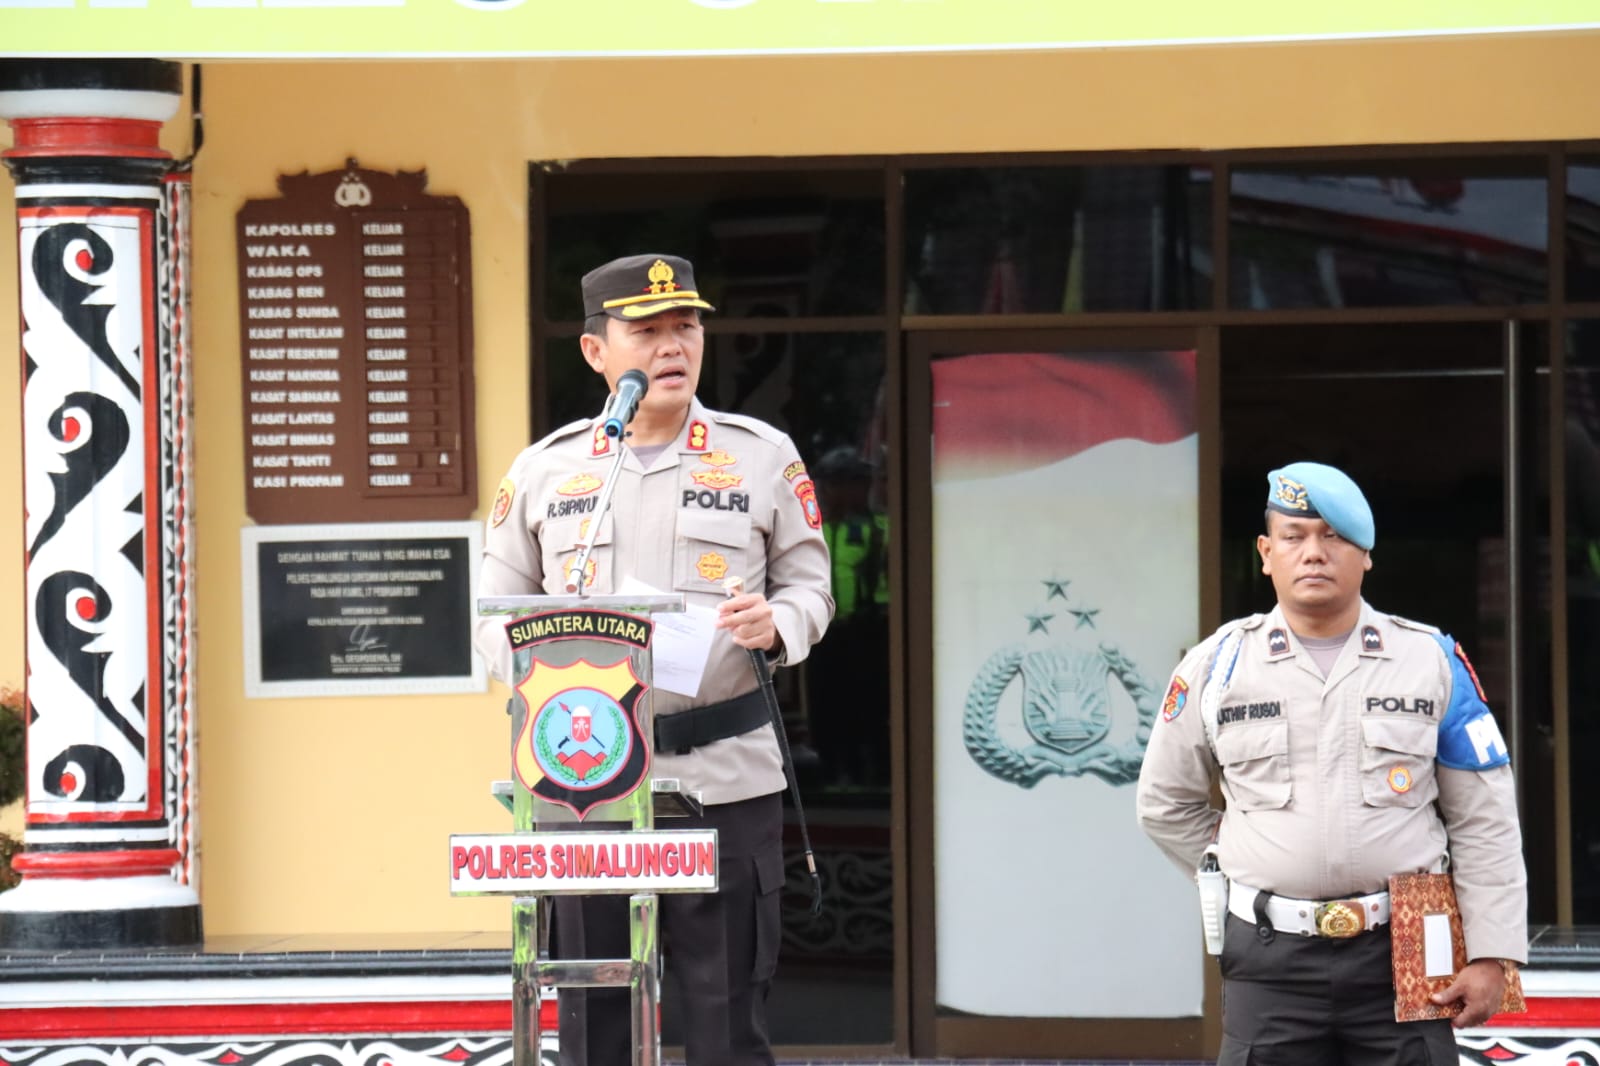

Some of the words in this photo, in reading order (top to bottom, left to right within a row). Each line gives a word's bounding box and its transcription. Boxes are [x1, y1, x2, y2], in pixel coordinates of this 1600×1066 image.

[245, 224, 336, 236] KAPOLRES
[363, 224, 403, 235] KELUAR
[247, 245, 310, 257] WAKA
[364, 245, 404, 256] KELUAR
[247, 266, 293, 277] KABAG
[296, 266, 323, 277] OPS
[364, 266, 404, 277] KELUAR
[248, 287, 293, 298] KABAG
[297, 287, 324, 298] REN
[364, 287, 405, 297] KELUAR
[248, 308, 292, 318] KABAG
[296, 307, 339, 318] SUMDA
[366, 308, 405, 318] KELUAR
[249, 328, 284, 339] KASAT
[367, 328, 406, 338] KELUAR
[250, 349, 284, 359] KASAT
[287, 348, 339, 359] RESKRIM
[367, 349, 406, 359] KELUAR
[250, 371, 285, 381] KASAT
[287, 370, 340, 381] NARKOBA
[367, 370, 408, 381] KELUAR
[251, 392, 286, 402] KASAT
[288, 392, 341, 402] SABHARA
[368, 391, 408, 403] KELUAR
[252, 413, 287, 424] KASAT
[288, 413, 335, 424] LANTAS
[369, 412, 409, 423] KELUAR
[252, 435, 287, 445] KASAT
[289, 434, 334, 445] BINMAS
[369, 433, 409, 444] KELUAR
[253, 456, 289, 467] KASAT
[291, 455, 331, 466] TAHTI
[253, 477, 286, 488] KASI
[290, 475, 344, 487] PROPAM
[370, 474, 410, 486] KELUAR
[682, 489, 749, 514] POLRI
[351, 551, 381, 562] TUHAN
[382, 550, 406, 561] YANG
[406, 549, 432, 560] MAHA
[433, 549, 451, 560] ESA
[511, 615, 594, 645] SUMATERA
[597, 617, 646, 643] UTARA
[1366, 696, 1434, 717] POLRI
[452, 843, 547, 880] POLRES
[550, 841, 715, 879] SIMALUNGUN
